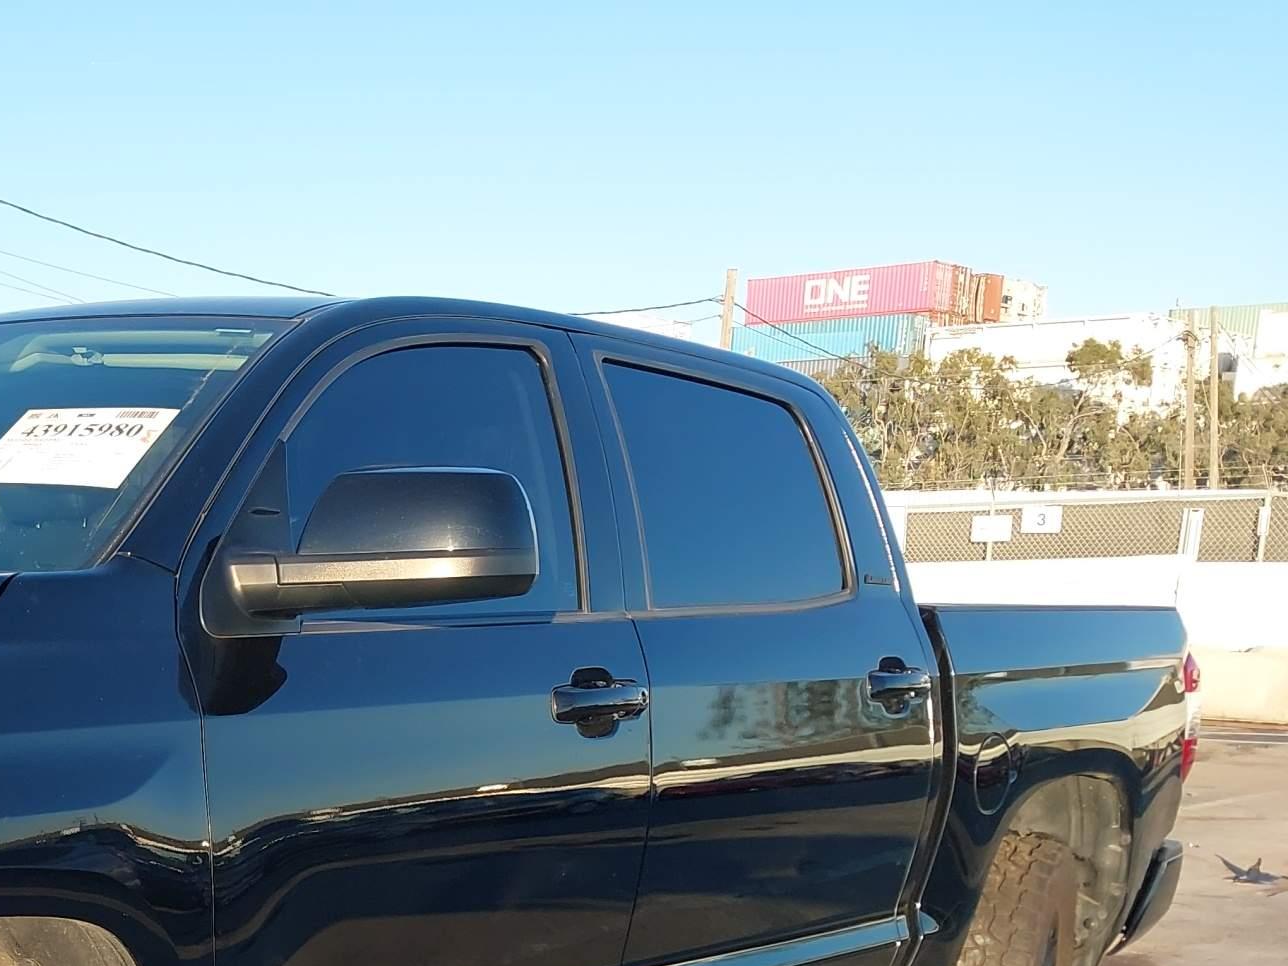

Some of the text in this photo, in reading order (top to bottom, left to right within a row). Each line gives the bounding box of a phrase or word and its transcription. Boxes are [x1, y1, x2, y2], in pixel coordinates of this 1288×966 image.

[804, 274, 870, 305] ONE
[21, 423, 144, 437] 43915980
[1037, 511, 1046, 526] 3
